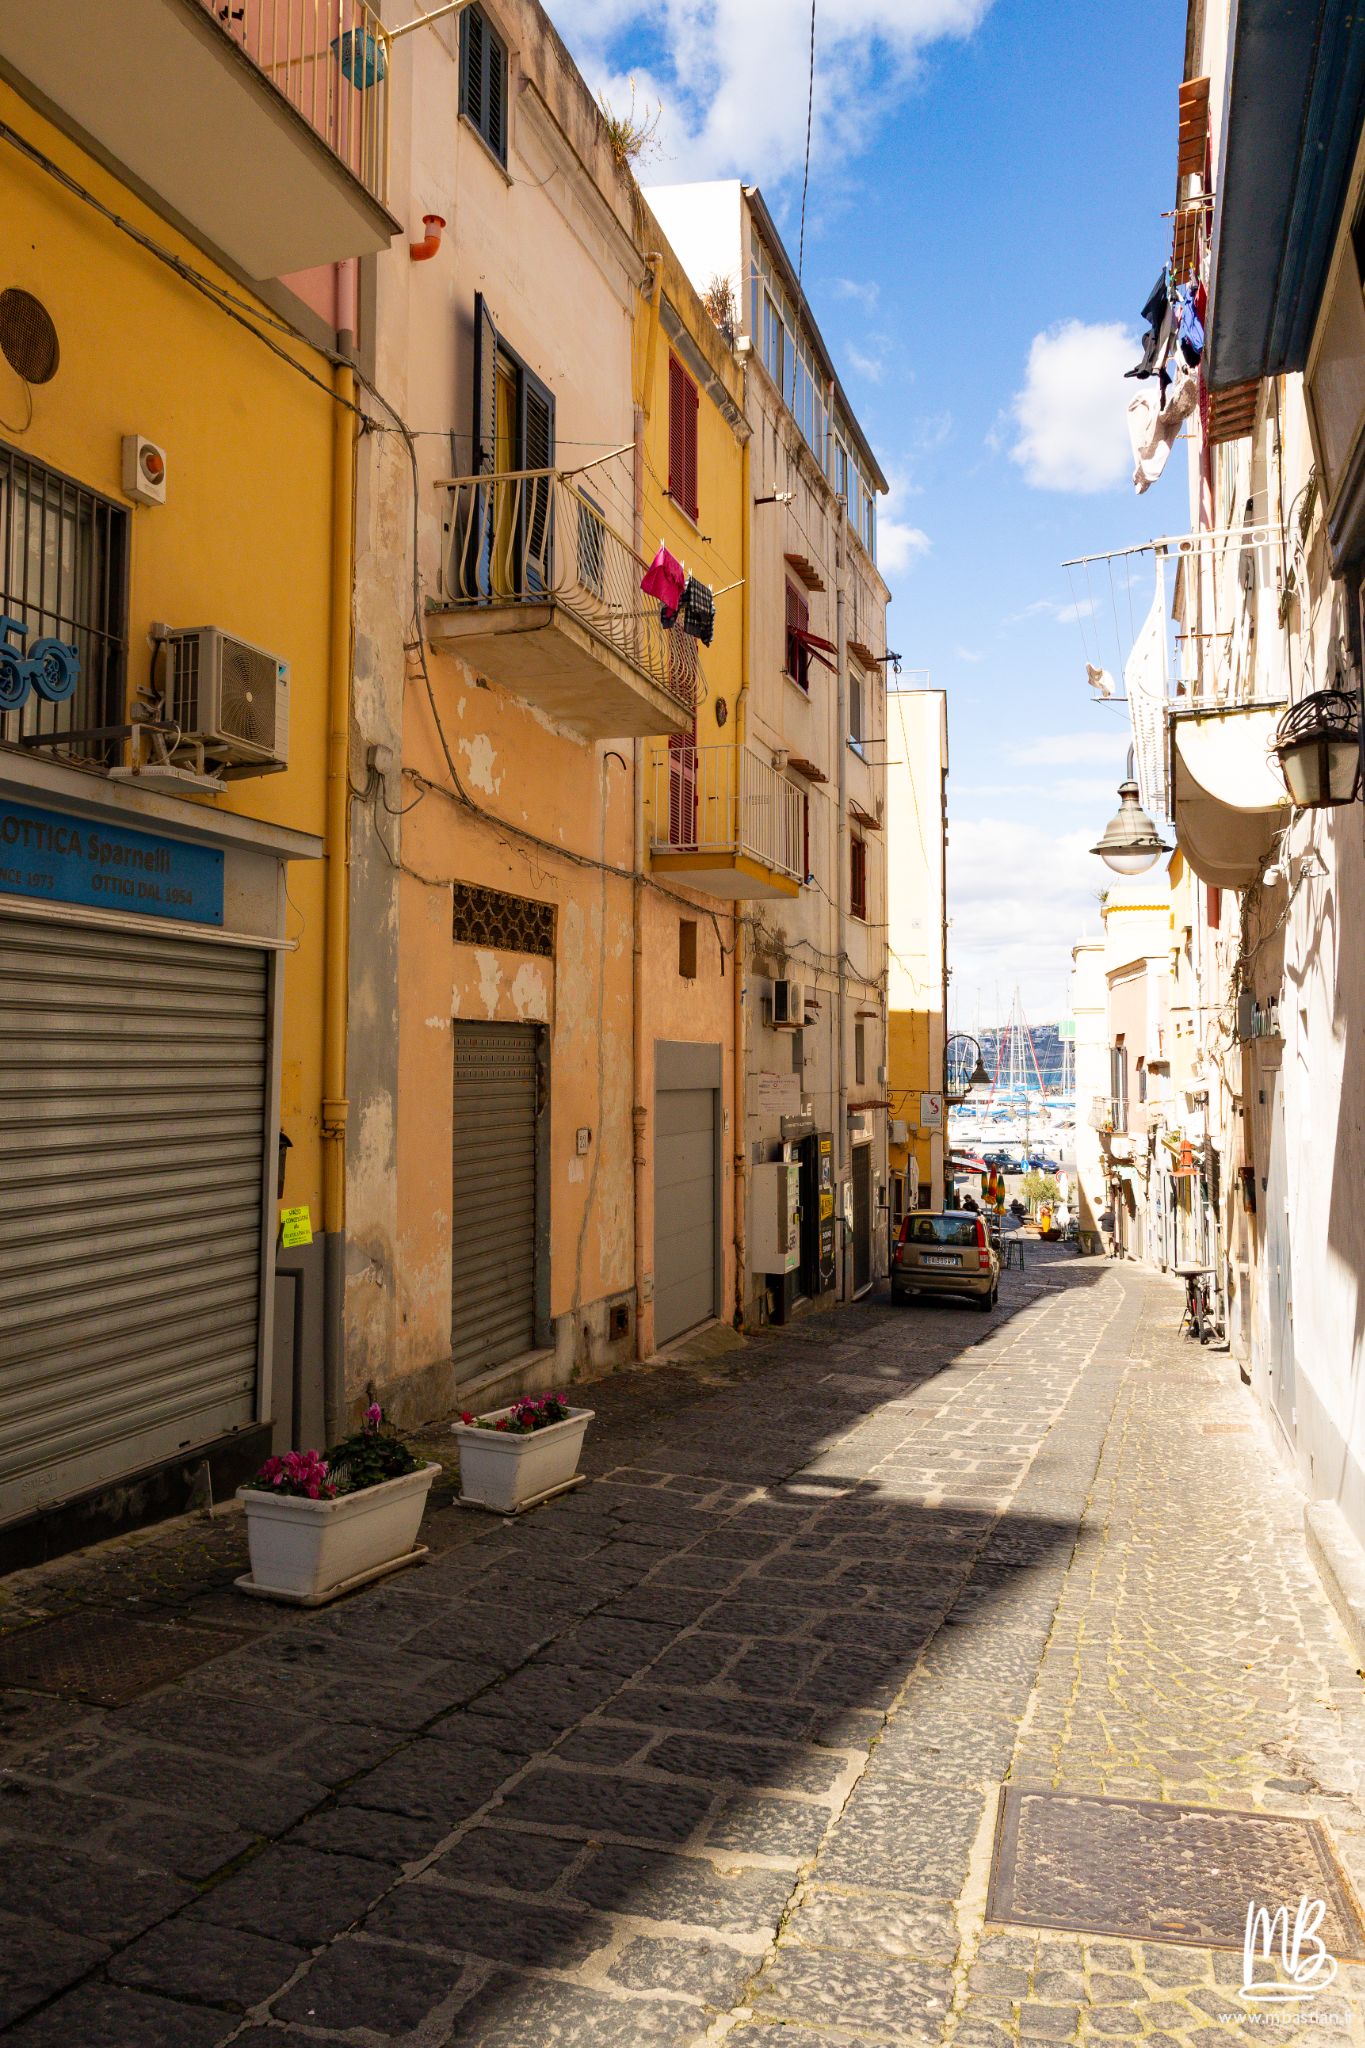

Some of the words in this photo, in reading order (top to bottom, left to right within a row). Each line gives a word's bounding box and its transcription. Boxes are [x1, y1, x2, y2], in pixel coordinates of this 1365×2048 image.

[2, 815, 83, 857] OTTICA
[88, 832, 170, 874] Sparnelli
[92, 873, 135, 897] OTTICI
[139, 881, 161, 901] DAL
[166, 887, 193, 905] 1954
